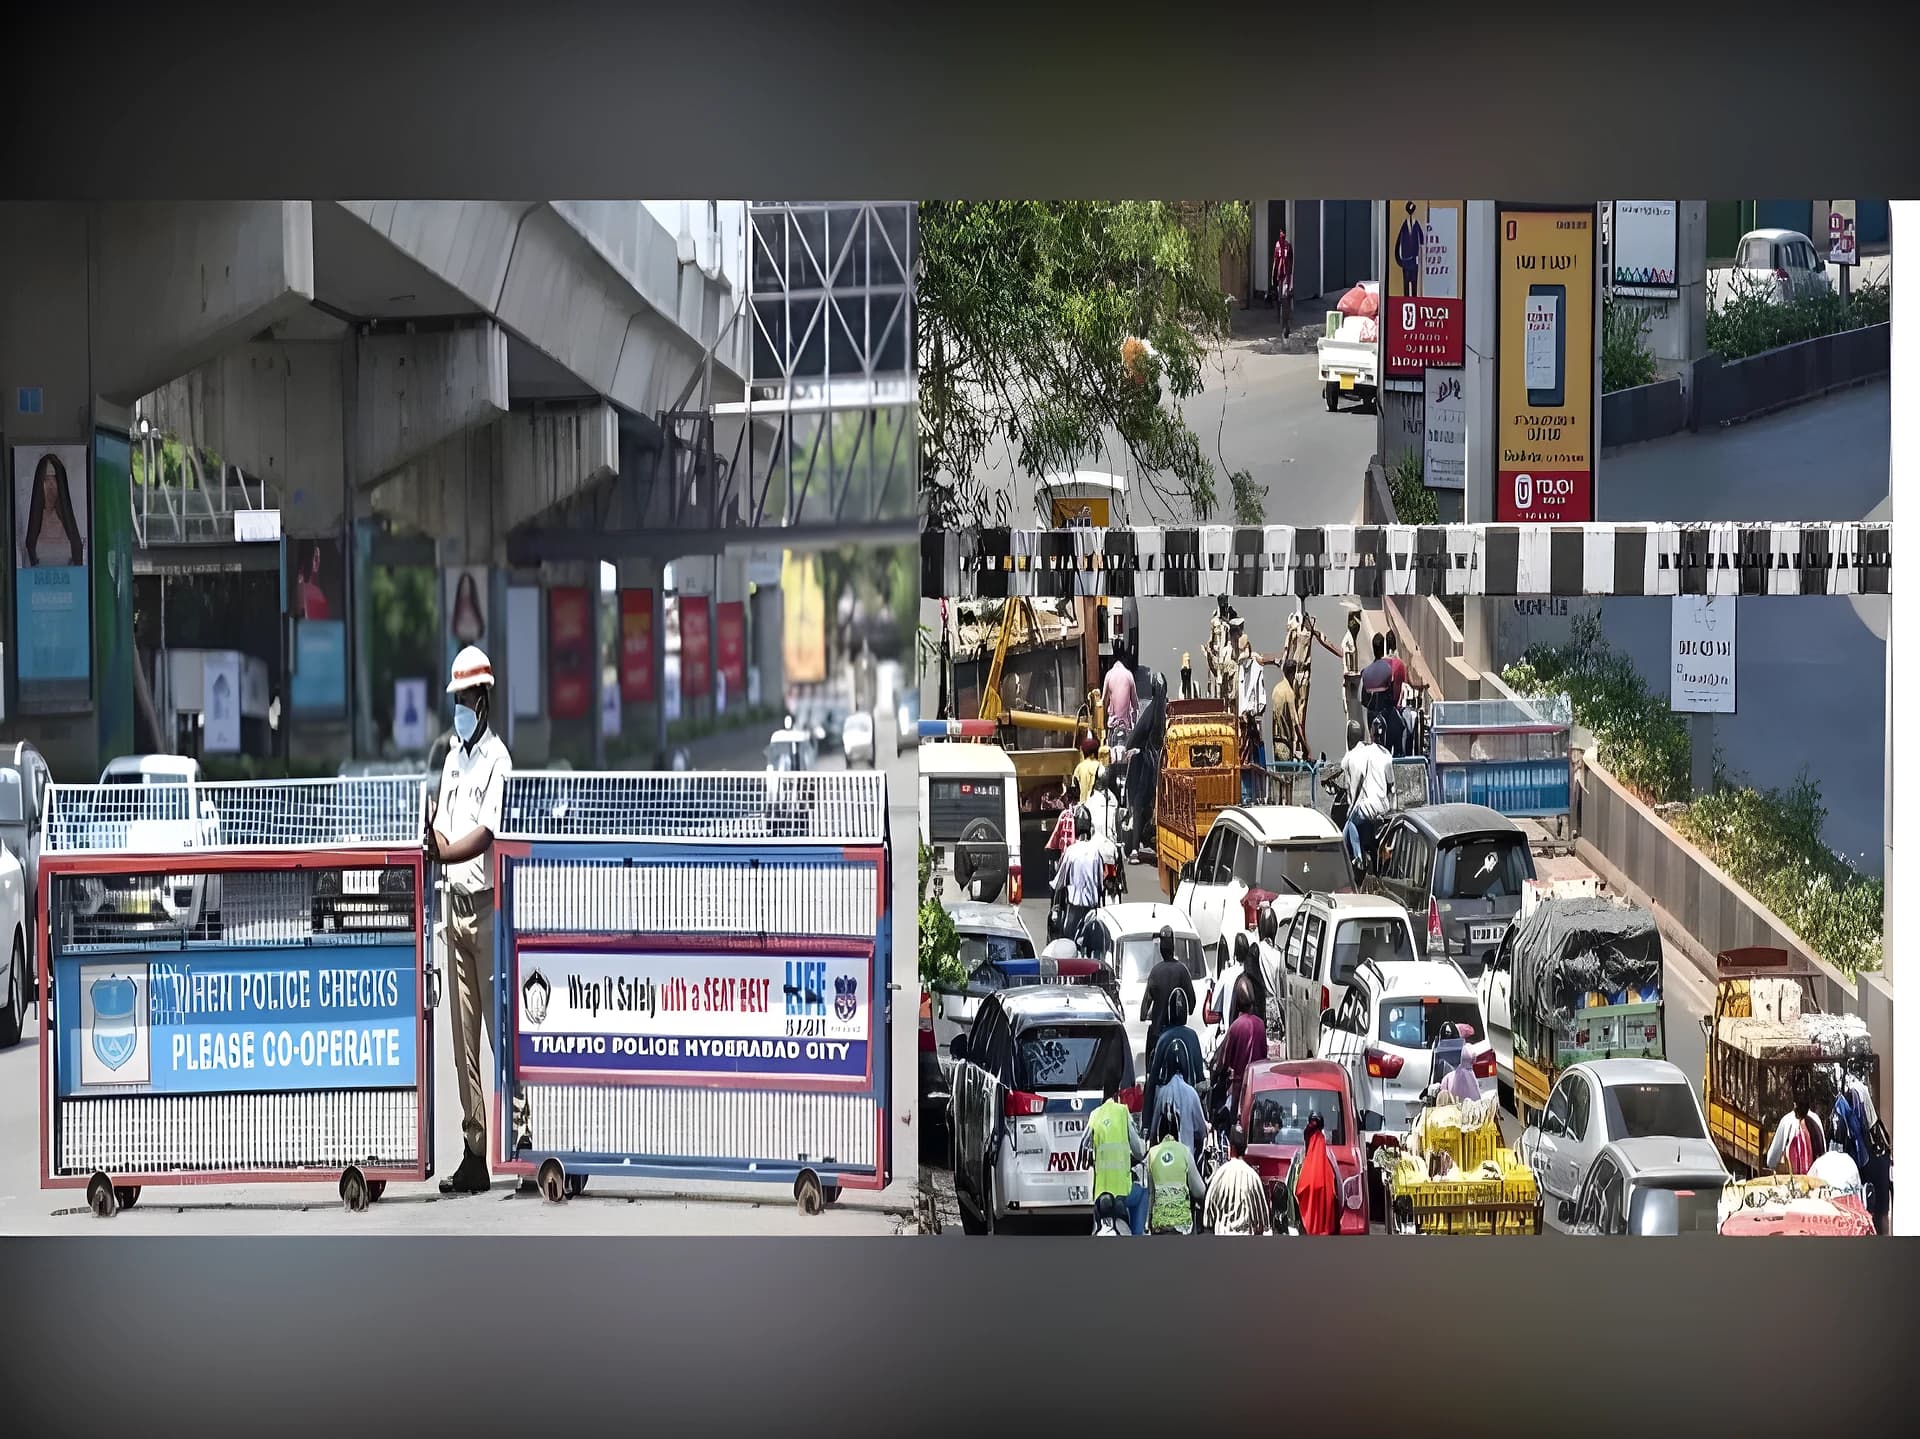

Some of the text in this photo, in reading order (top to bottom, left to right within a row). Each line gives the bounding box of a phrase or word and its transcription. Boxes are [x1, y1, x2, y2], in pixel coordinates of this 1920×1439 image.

[240, 970, 311, 1011] POLICE
[318, 968, 399, 1009] CHECKS
[703, 976, 736, 1012] SEAT
[172, 1028, 400, 1071] PLEASE CO-OPERATE
[612, 1036, 680, 1057] POLICE
